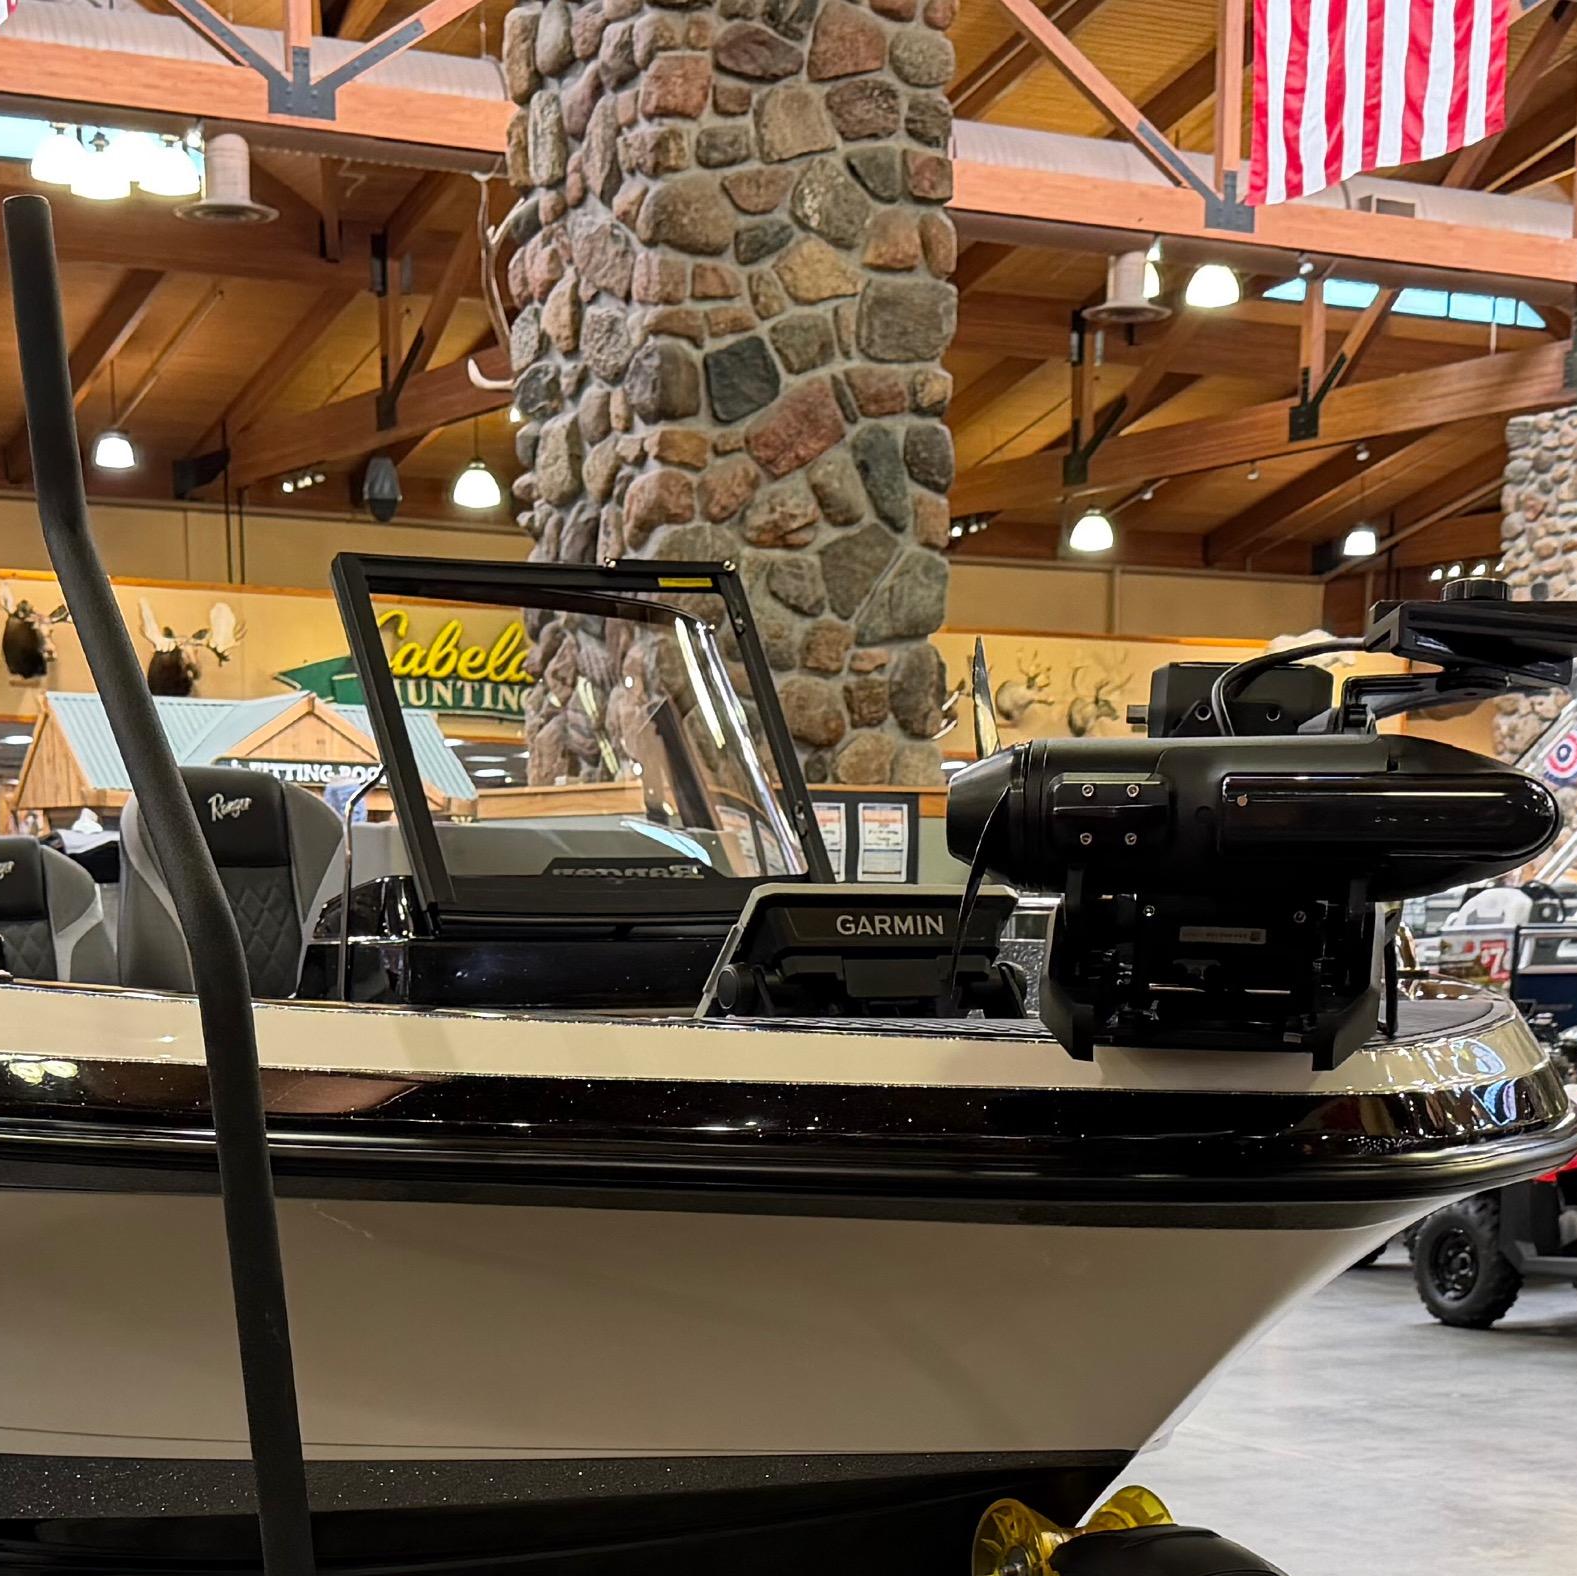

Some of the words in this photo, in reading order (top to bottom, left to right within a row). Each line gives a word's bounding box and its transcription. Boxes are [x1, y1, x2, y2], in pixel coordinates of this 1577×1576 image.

[394, 678, 530, 712] UNTIN
[207, 793, 253, 823] Ranger
[836, 915, 944, 936] GARMIN
